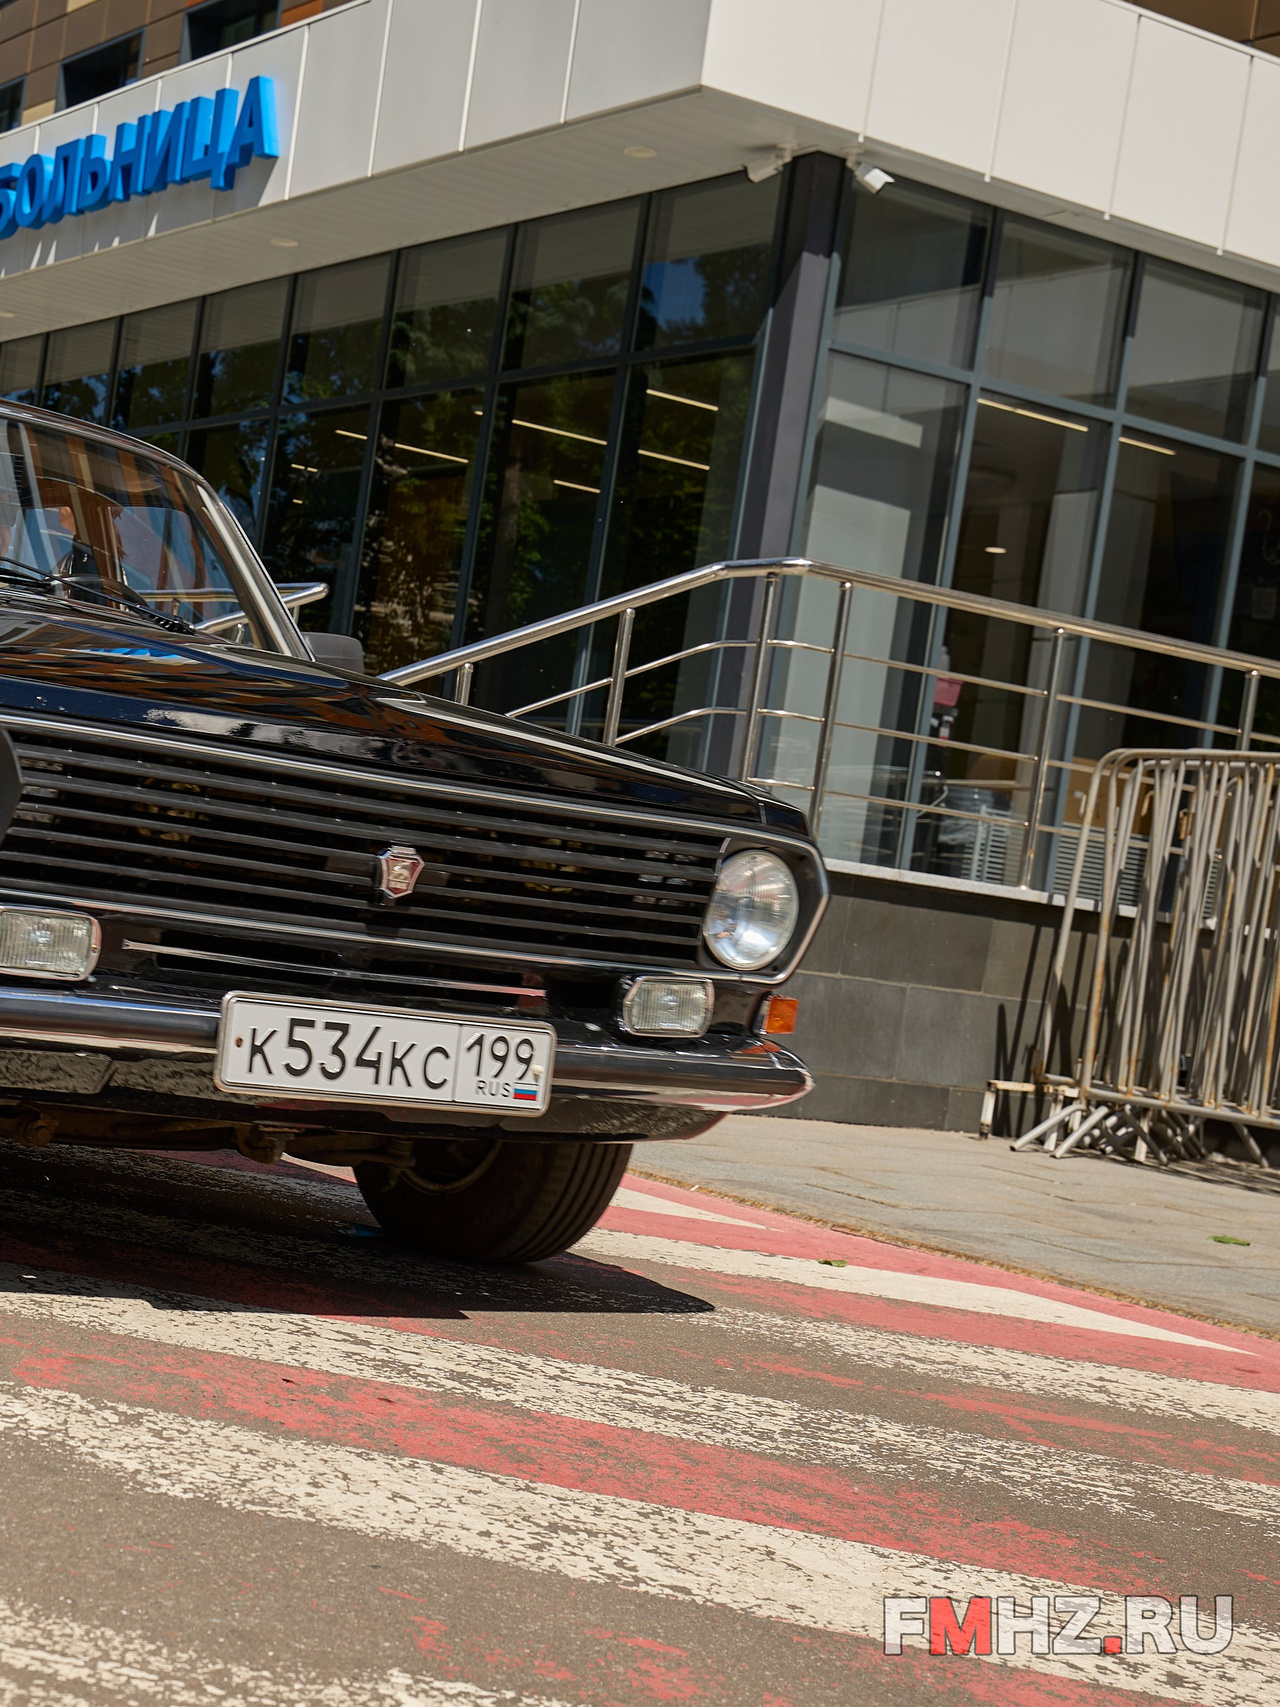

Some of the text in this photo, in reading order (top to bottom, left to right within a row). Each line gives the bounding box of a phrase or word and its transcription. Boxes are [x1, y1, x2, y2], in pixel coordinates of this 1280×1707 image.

[247, 1017, 535, 1090] К534КС 199
[475, 1080, 511, 1098] RUS
